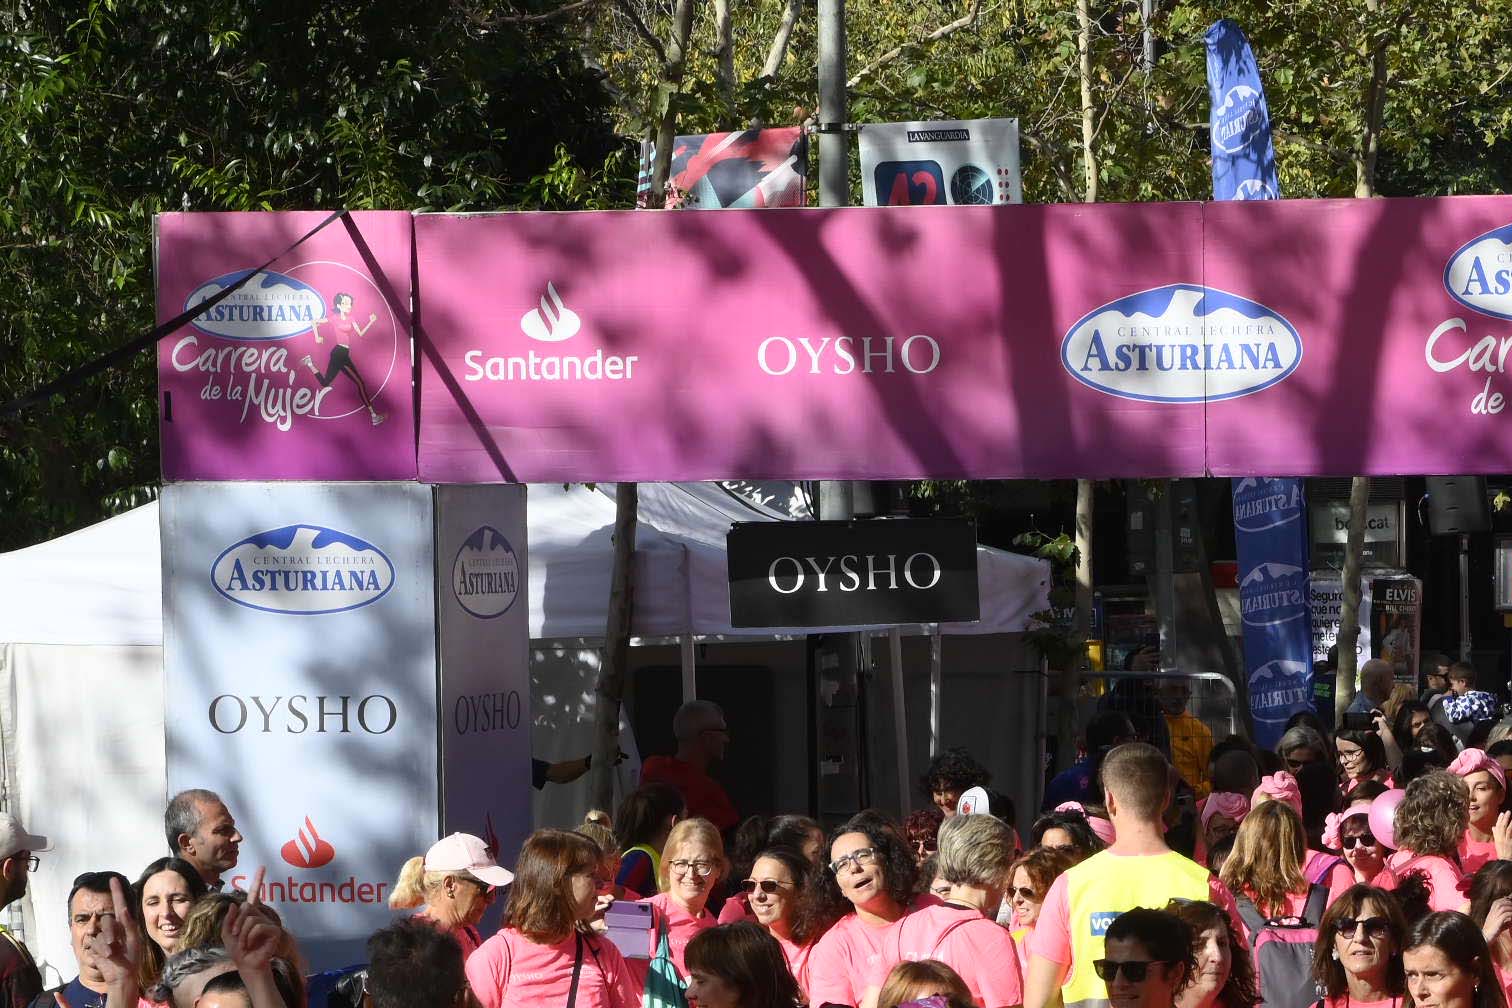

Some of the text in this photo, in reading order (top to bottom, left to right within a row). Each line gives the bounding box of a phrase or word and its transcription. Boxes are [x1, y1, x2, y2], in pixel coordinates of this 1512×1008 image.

[1117, 323, 1276, 337] CENTRAL LECHERA
[172, 336, 288, 372] Carrera
[464, 349, 638, 382] Santander
[757, 334, 942, 377] OYSHO
[1080, 335, 1284, 373] ASTURIANA
[200, 370, 333, 431] de la Mujer
[1471, 376, 1505, 415] de
[226, 557, 382, 593] ASTURIANA
[253, 554, 375, 566] CENTRAL LECHERA
[768, 552, 941, 594] OYSHO
[458, 562, 516, 596] ASTURIANA
[1385, 588, 1417, 601] ELVIS
[208, 694, 398, 735] OYSHO
[455, 691, 521, 735] OYSHO
